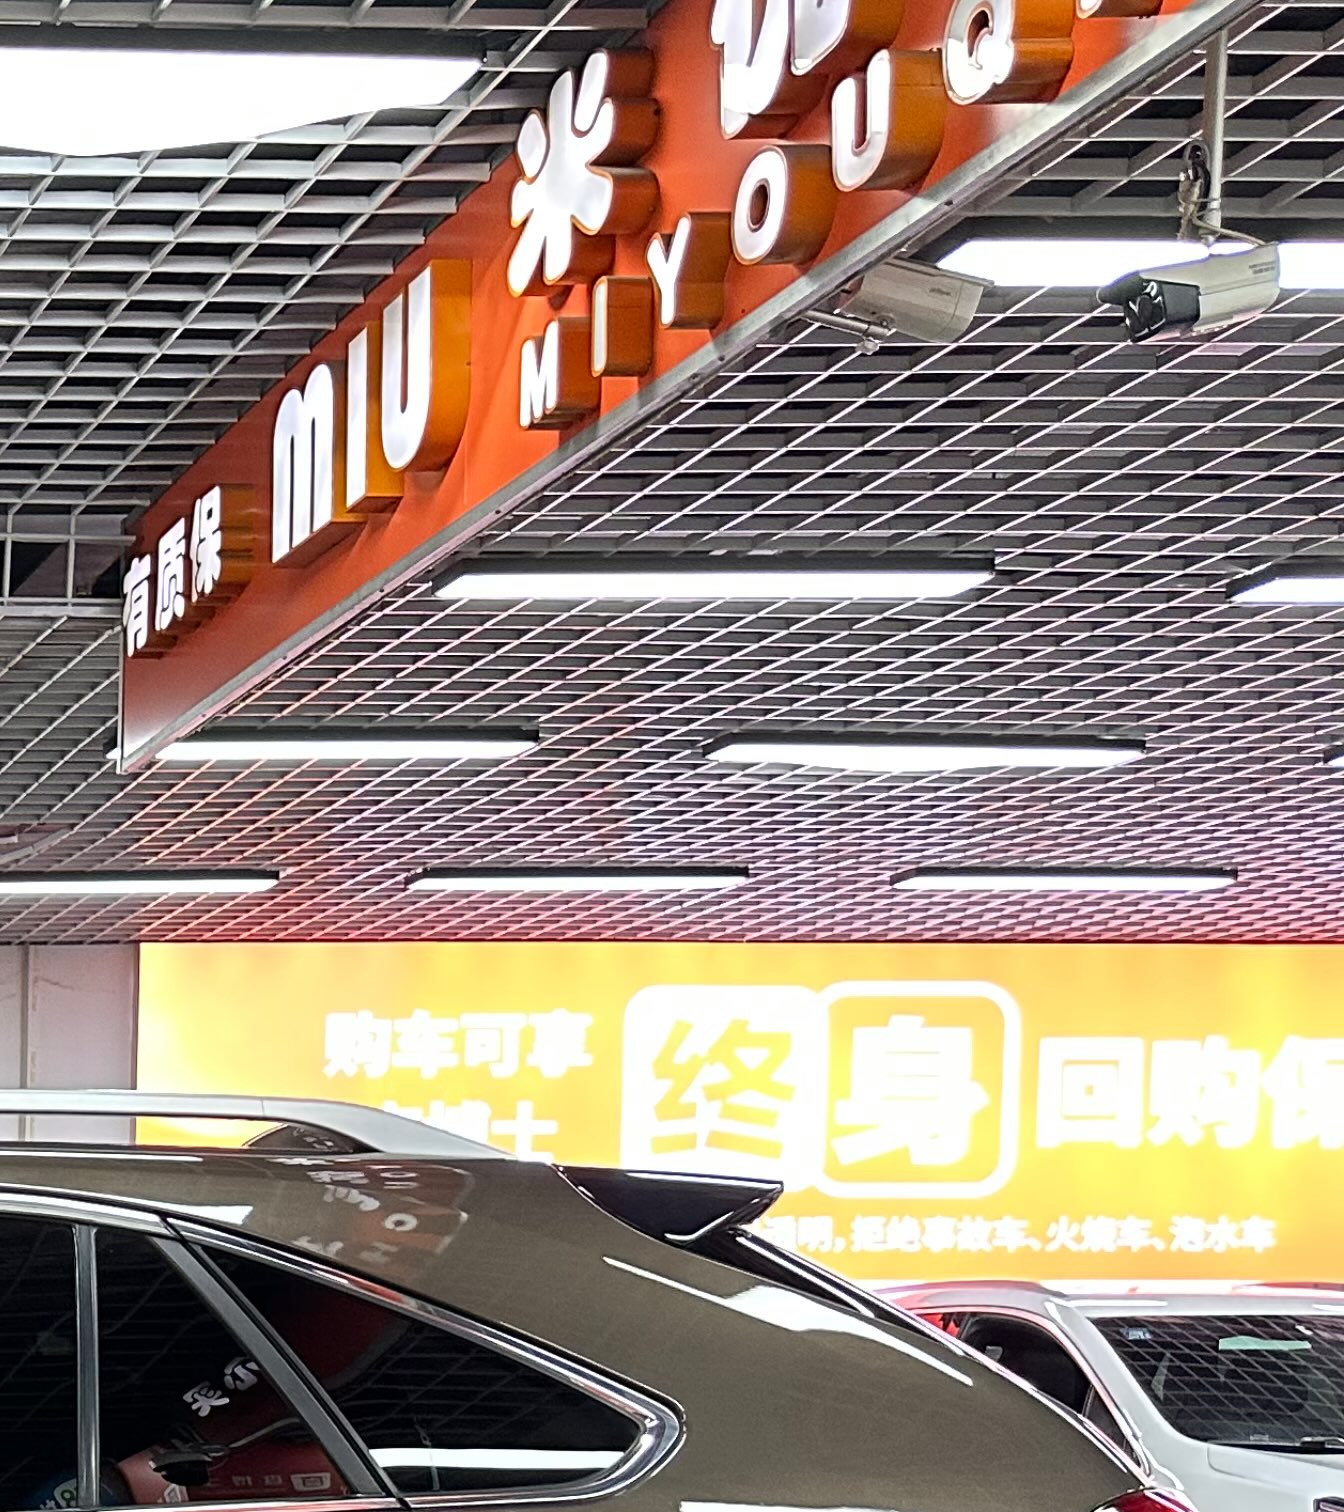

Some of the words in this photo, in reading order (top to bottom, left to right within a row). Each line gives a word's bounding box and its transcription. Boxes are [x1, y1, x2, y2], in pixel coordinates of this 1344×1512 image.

[271, 260, 439, 563] MIU
[122, 485, 222, 658] 有质保
